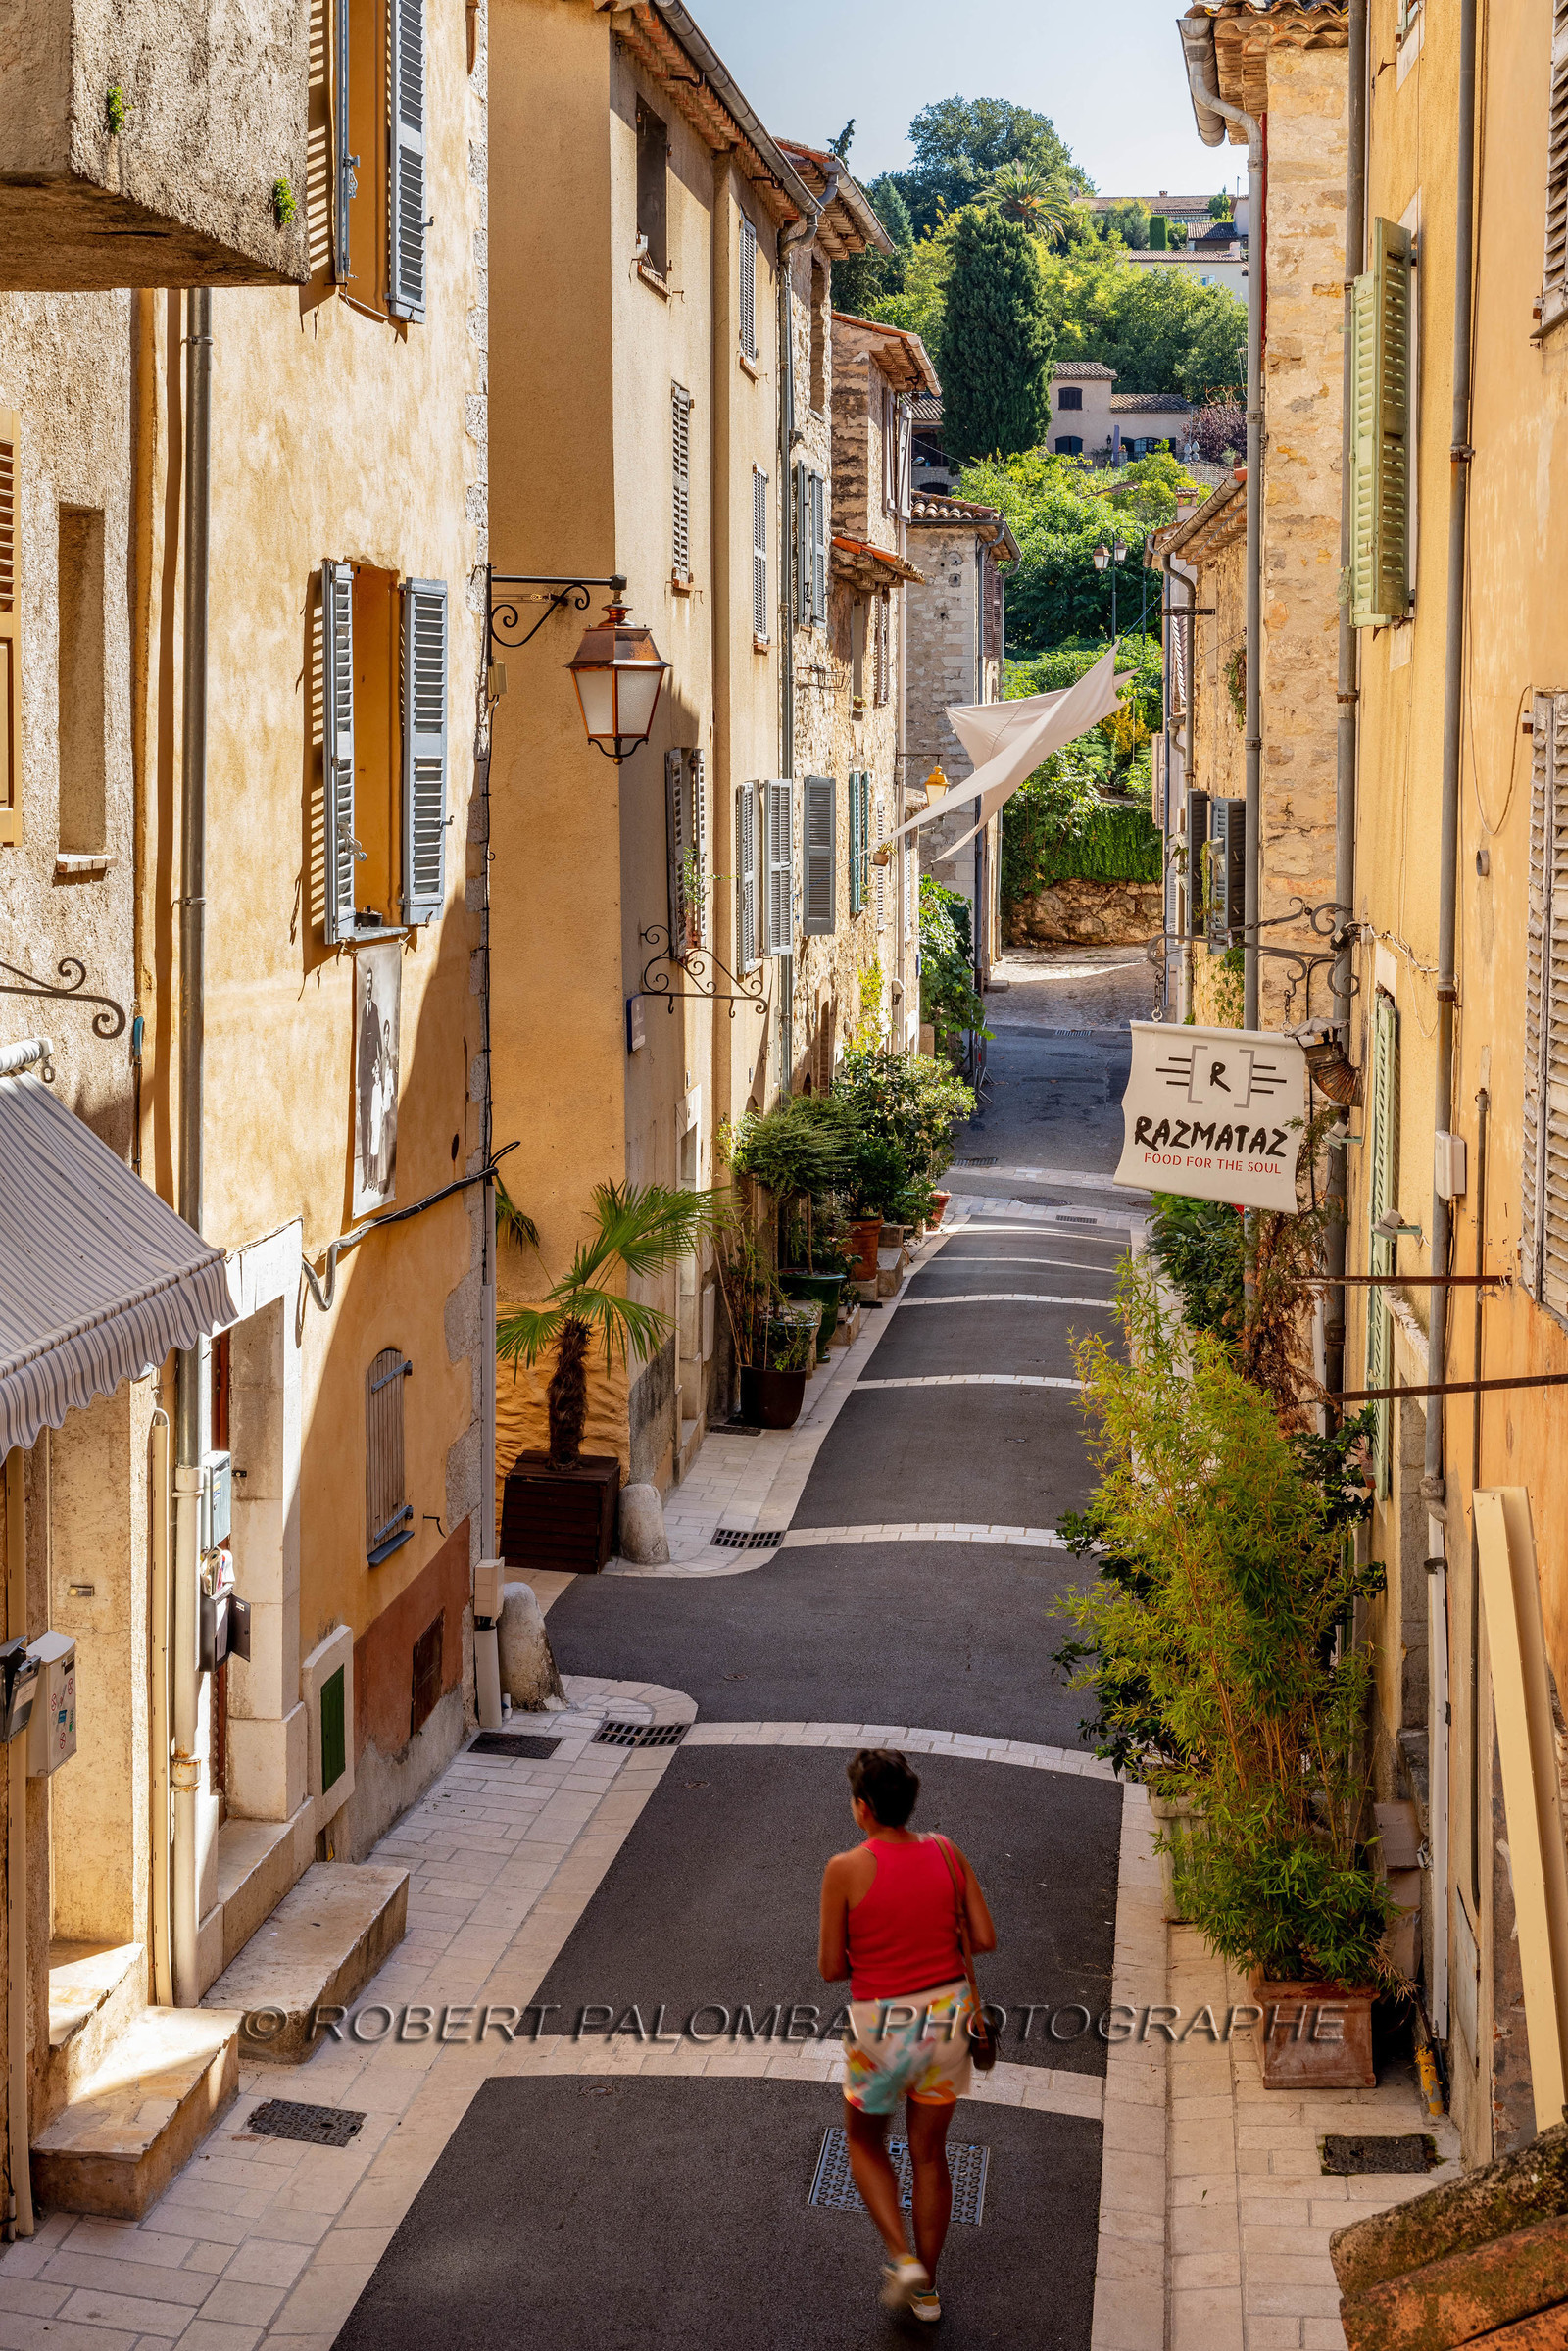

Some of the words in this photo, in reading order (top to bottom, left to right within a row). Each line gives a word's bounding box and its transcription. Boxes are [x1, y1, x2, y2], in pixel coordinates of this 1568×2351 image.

[1209, 1061, 1232, 1093] R
[1134, 1115, 1289, 1158] RAZMATAZ
[1144, 1152, 1182, 1166] FOOD
[1186, 1155, 1212, 1169] FOR
[1216, 1158, 1244, 1172] THE
[1247, 1161, 1282, 1175] SOUL
